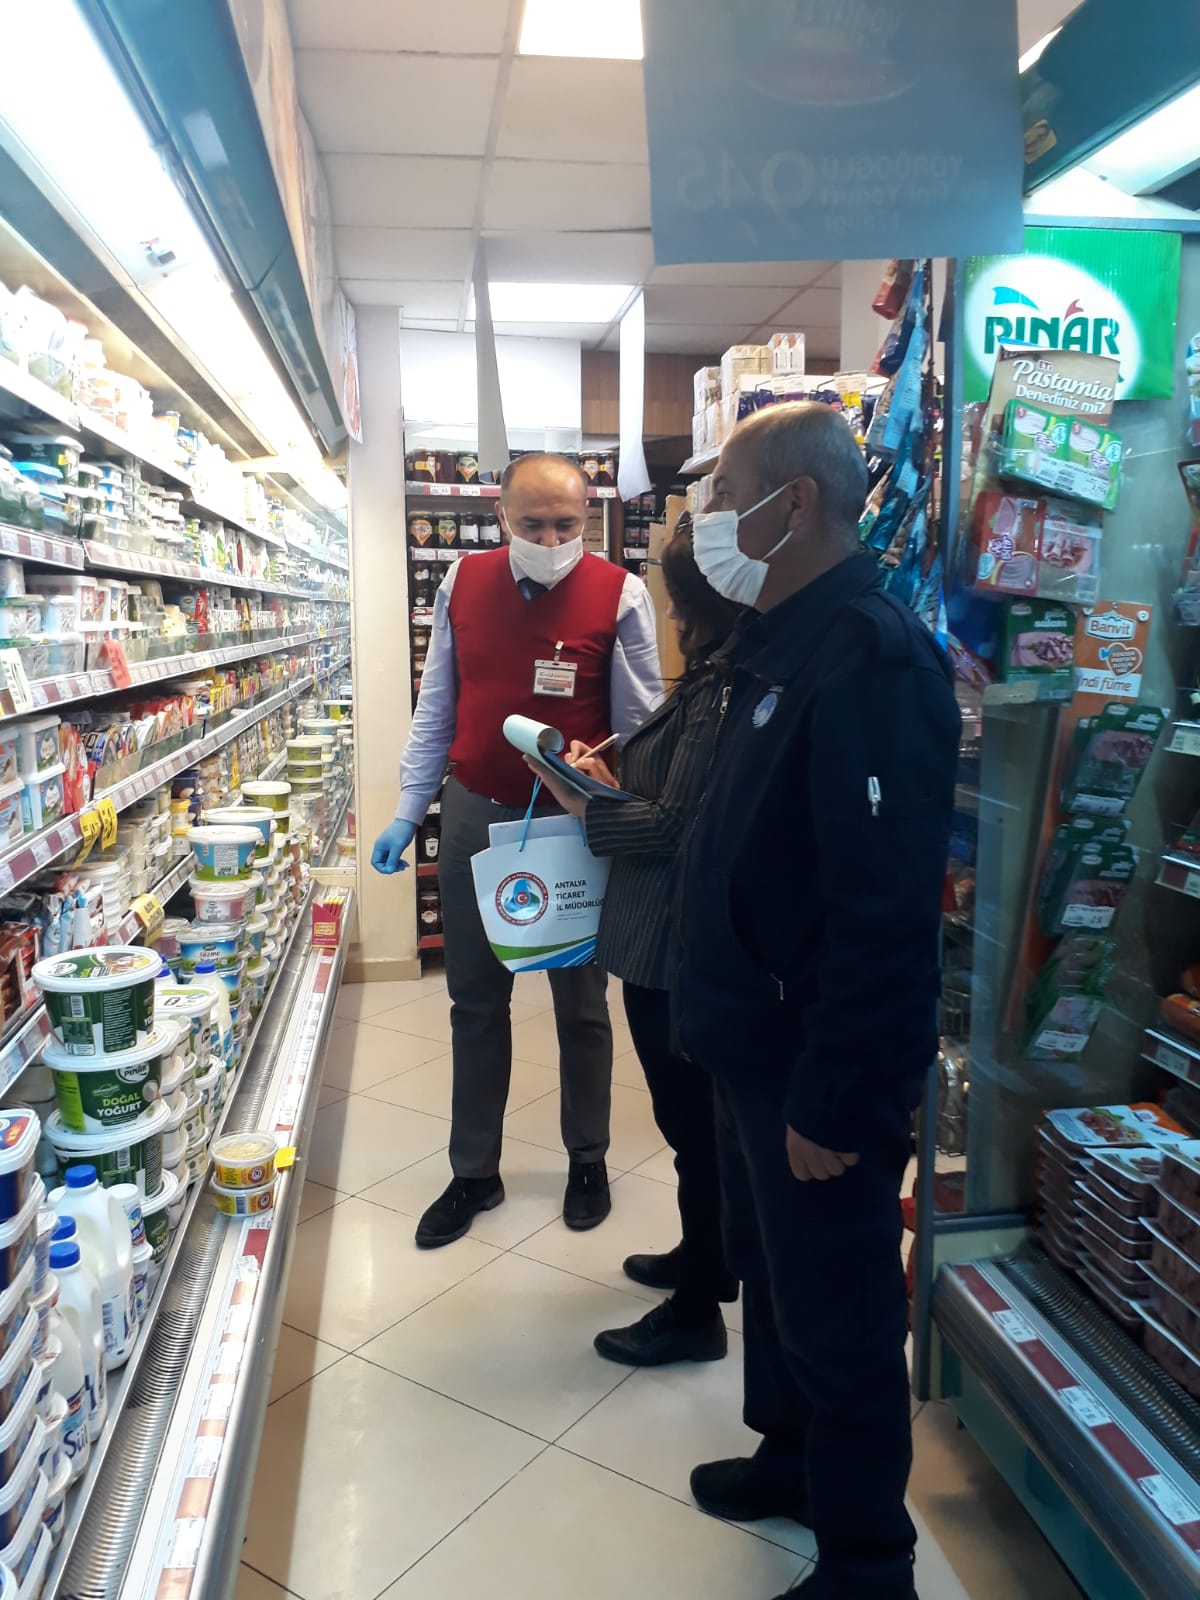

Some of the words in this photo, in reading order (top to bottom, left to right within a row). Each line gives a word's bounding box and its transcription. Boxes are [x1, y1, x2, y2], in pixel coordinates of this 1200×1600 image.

[1012, 359, 1114, 401] Pastamia
[1016, 384, 1079, 410] Denediniz
[1081, 402, 1106, 414] mi?
[1091, 620, 1130, 635] Banvit
[1100, 677, 1132, 692] füme
[555, 879, 587, 889] ANTALYA
[556, 889, 586, 900] TİCARET
[556, 902, 564, 912] İL
[102, 1092, 140, 1107] DOĞAL
[97, 1101, 142, 1117] YOĞURT
